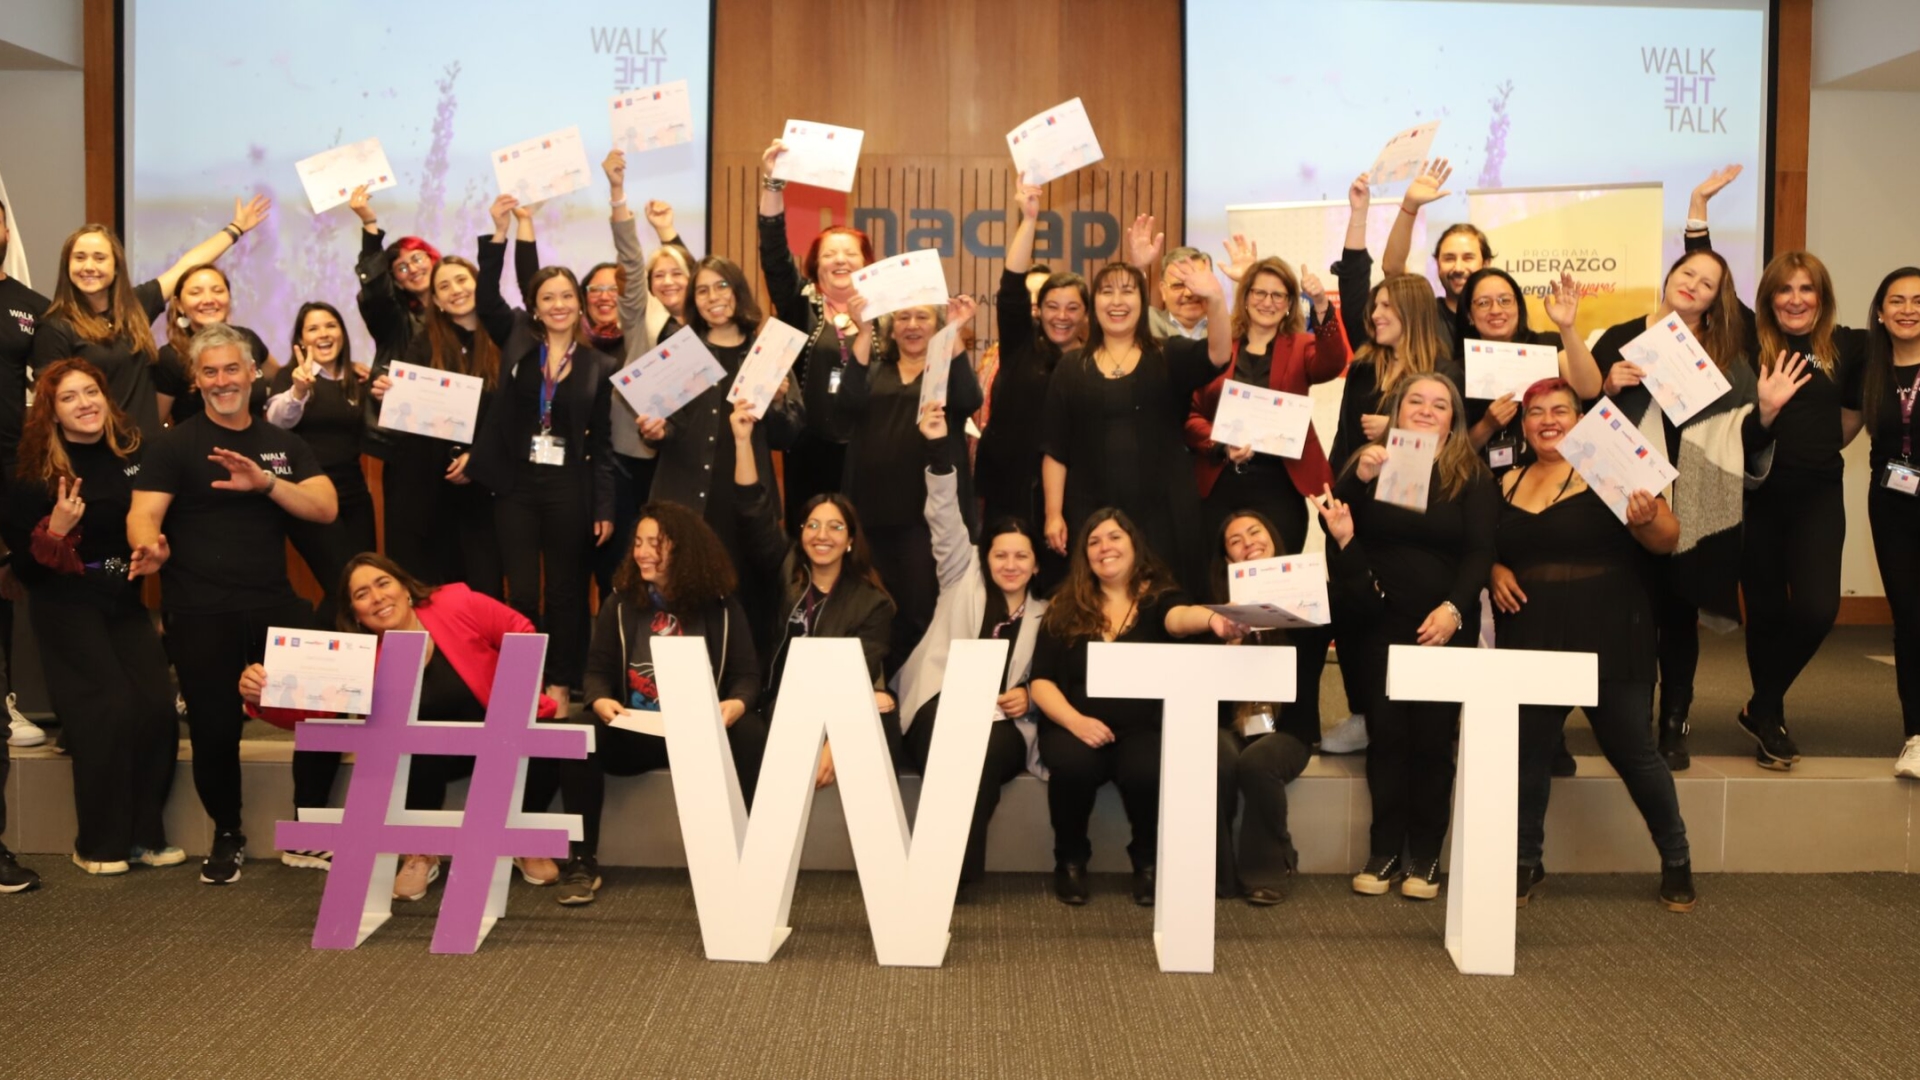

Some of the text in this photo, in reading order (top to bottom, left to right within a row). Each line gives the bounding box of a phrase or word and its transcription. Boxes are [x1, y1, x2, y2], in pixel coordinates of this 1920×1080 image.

[590, 26, 667, 55] WALK
[1641, 46, 1715, 75] WALK
[1664, 105, 1727, 134] TALK
[1523, 248, 1599, 257] PROGRAMA
[1505, 258, 1617, 273] LIDERAZGO
[9, 309, 34, 321] WALK
[260, 451, 287, 461] WALK
